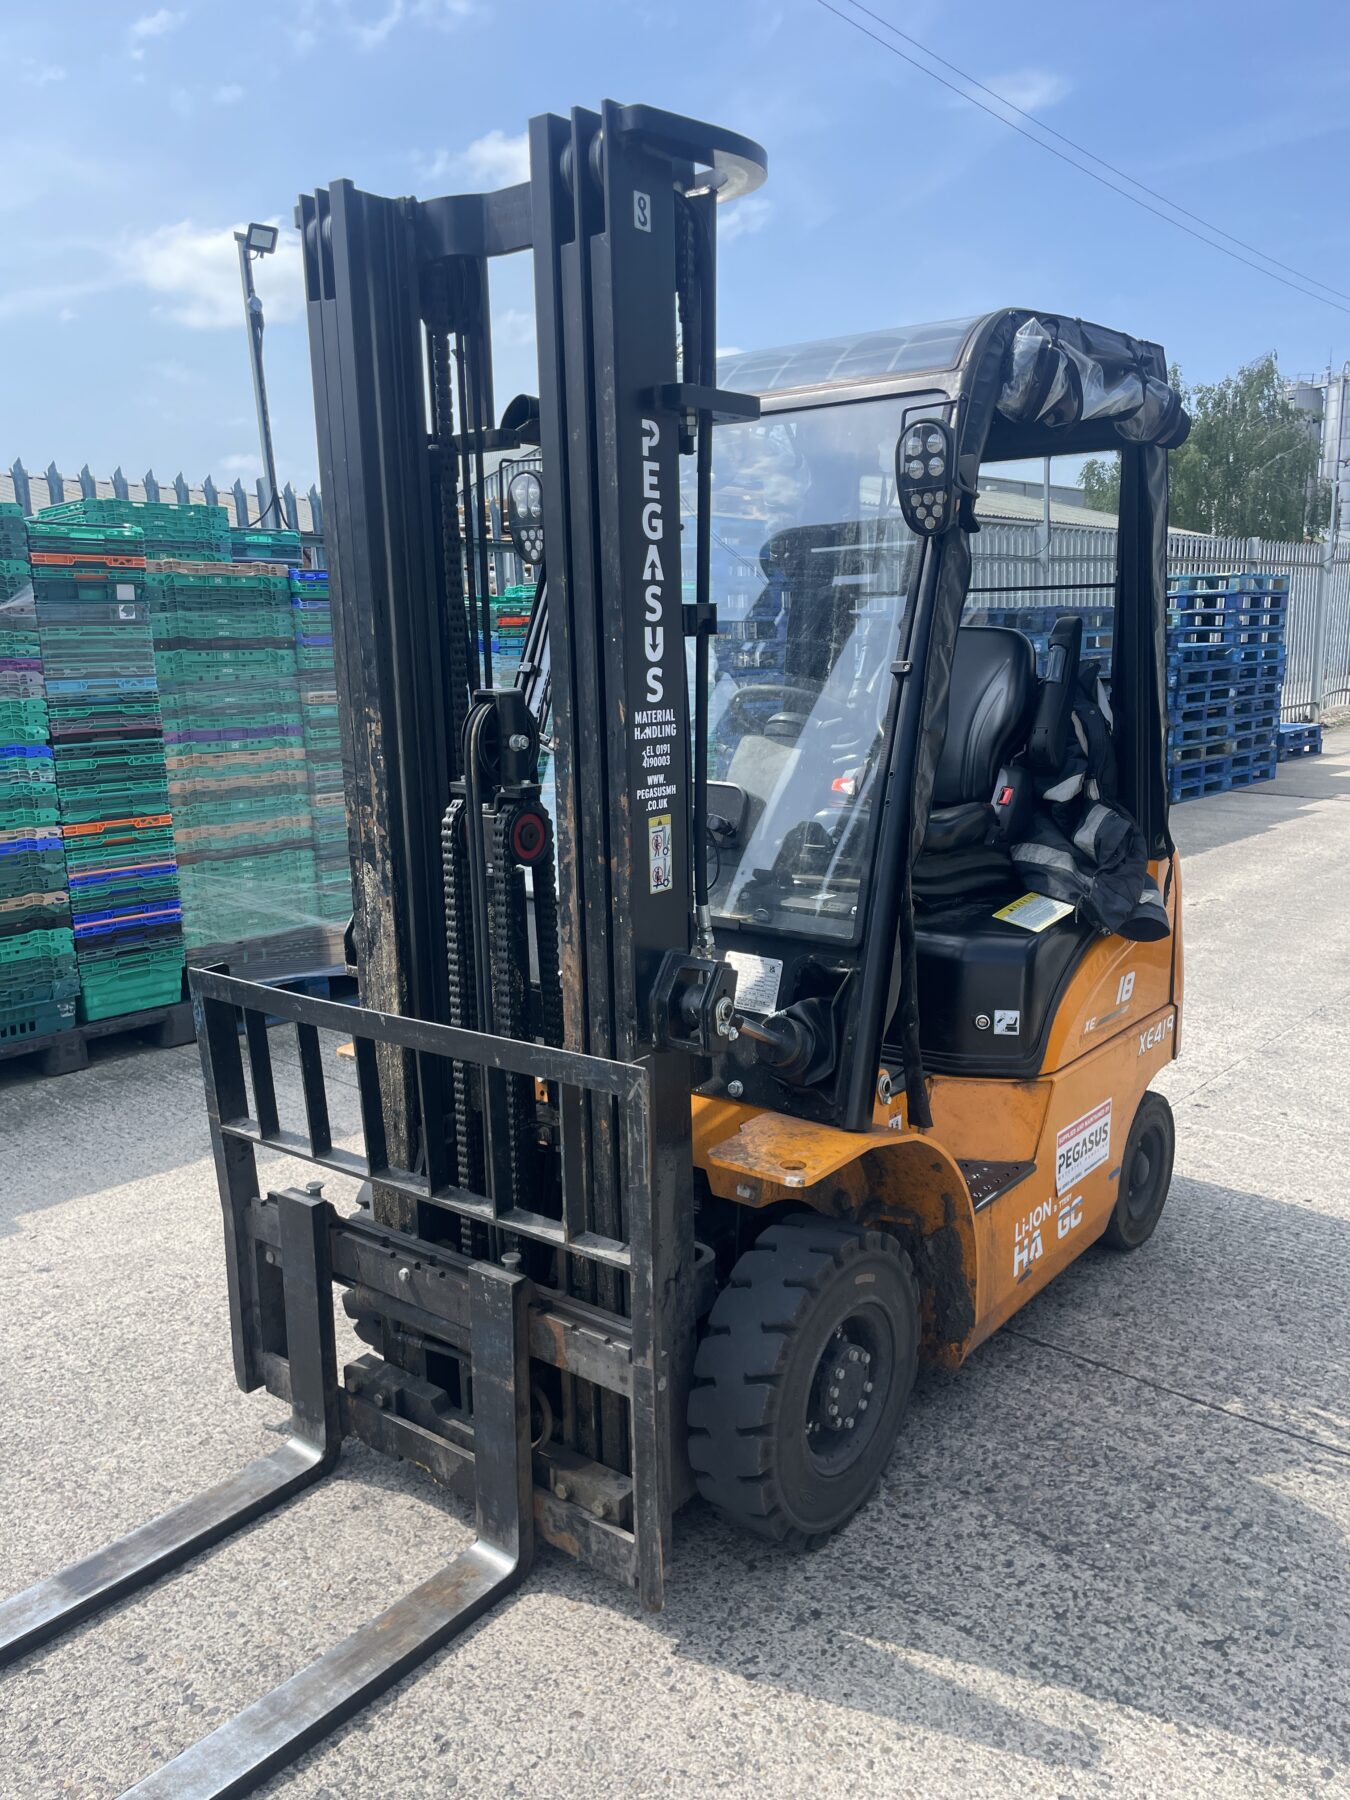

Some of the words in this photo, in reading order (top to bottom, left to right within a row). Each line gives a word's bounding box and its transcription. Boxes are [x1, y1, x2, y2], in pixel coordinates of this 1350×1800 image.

[641, 418, 665, 703] PEGASUS
[634, 708, 675, 725] MATERIAL
[634, 724, 677, 740] HANDLING
[655, 743, 671, 755] 0191
[642, 755, 671, 769] 4190003
[636, 784, 677, 800] PEGASUSMH
[645, 798, 668, 812] .CO.UK
[1115, 971, 1136, 1006] 18
[1083, 1016, 1097, 1035] XE
[1058, 1122, 1109, 1175] PEGASUS
[1015, 1197, 1052, 1243] Li-ION
